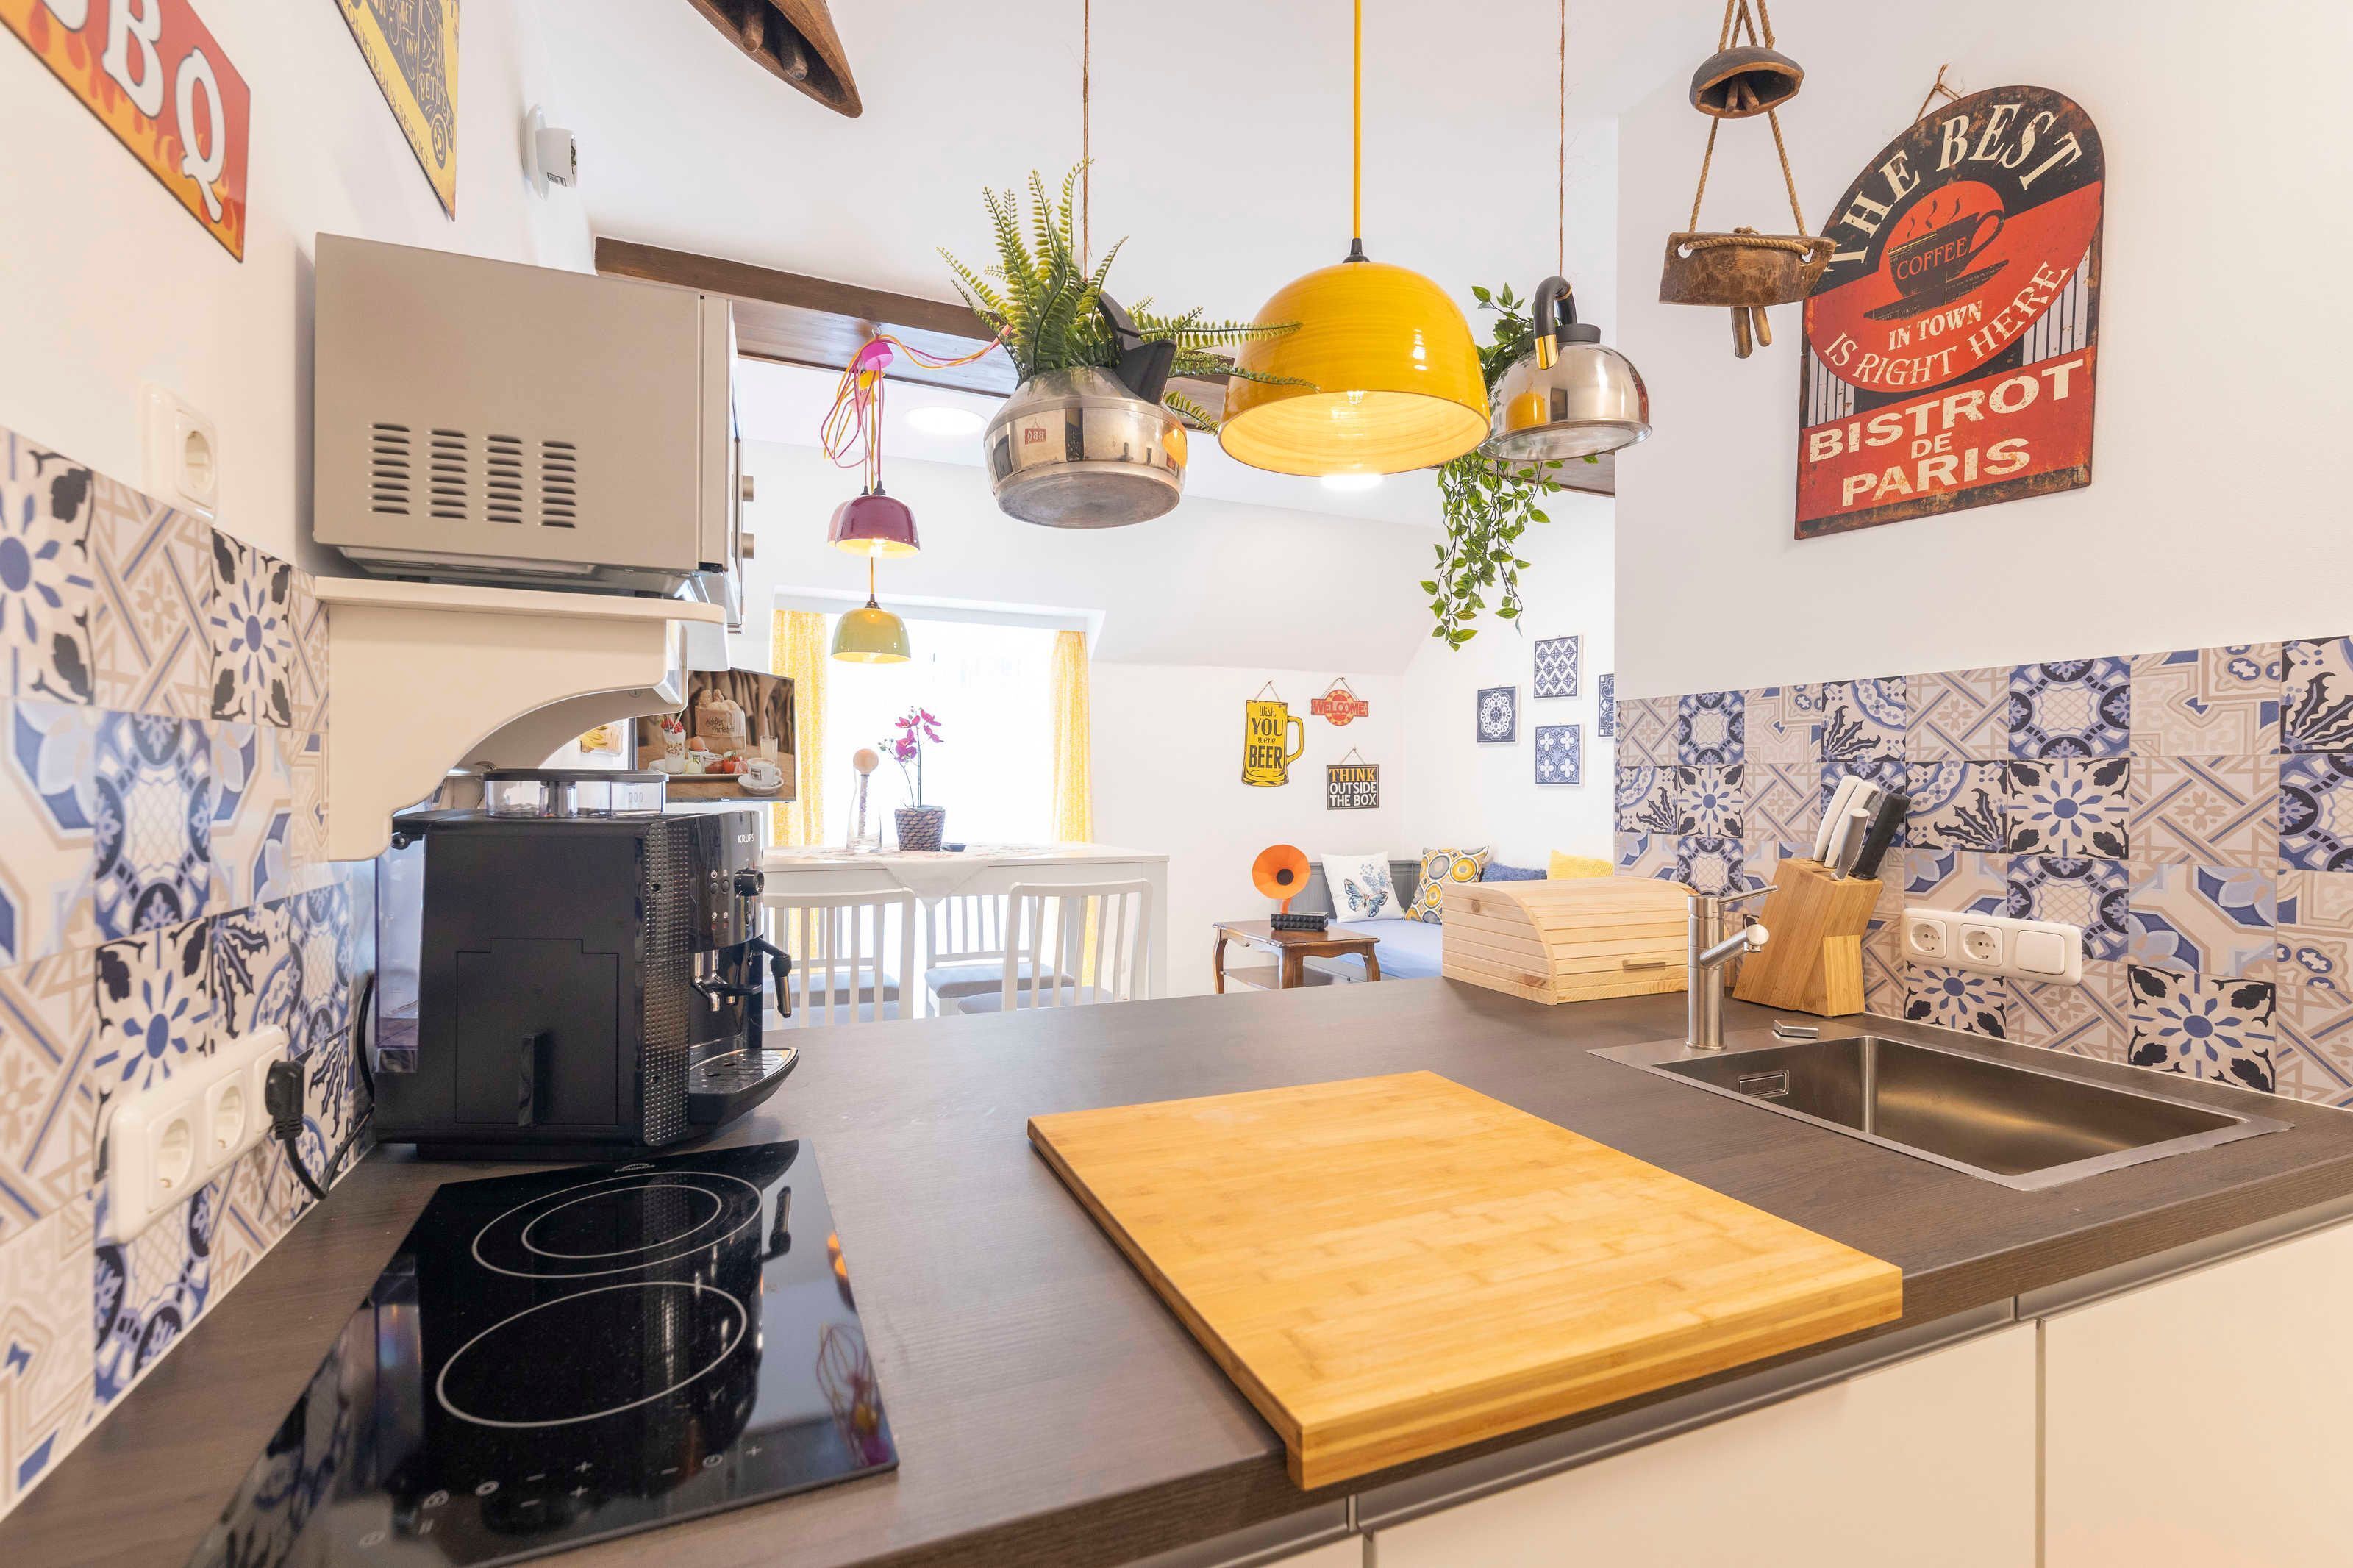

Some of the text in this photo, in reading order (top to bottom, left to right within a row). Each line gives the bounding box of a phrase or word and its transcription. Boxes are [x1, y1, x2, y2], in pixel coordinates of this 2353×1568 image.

[42, 0, 226, 224] BQ
[398, 104, 430, 168] SERVICE
[1935, 103, 2086, 193] BEST
[1896, 236, 1968, 280] COFFEE
[1824, 331, 1860, 368] IS
[1852, 346, 1960, 386] RIGHT
[1968, 259, 2071, 363] HERE
[1888, 323, 1913, 352] IN
[1916, 299, 1984, 339] TOWN
[1808, 359, 2085, 464] BISTROT
[1910, 432, 1953, 460] DE
[1841, 437, 2031, 508] PARIS
[1259, 705, 1277, 717] Wish
[1314, 701, 1366, 715] WELCOME
[1252, 717, 1284, 737] YOU
[1257, 736, 1277, 744] were
[1249, 745, 1283, 770] BEER
[1329, 768, 1377, 782] THINK
[1329, 781, 1377, 795] OUTSIDE
[1329, 793, 1377, 806] THE BOX
[738, 834, 754, 843] KRUPS
